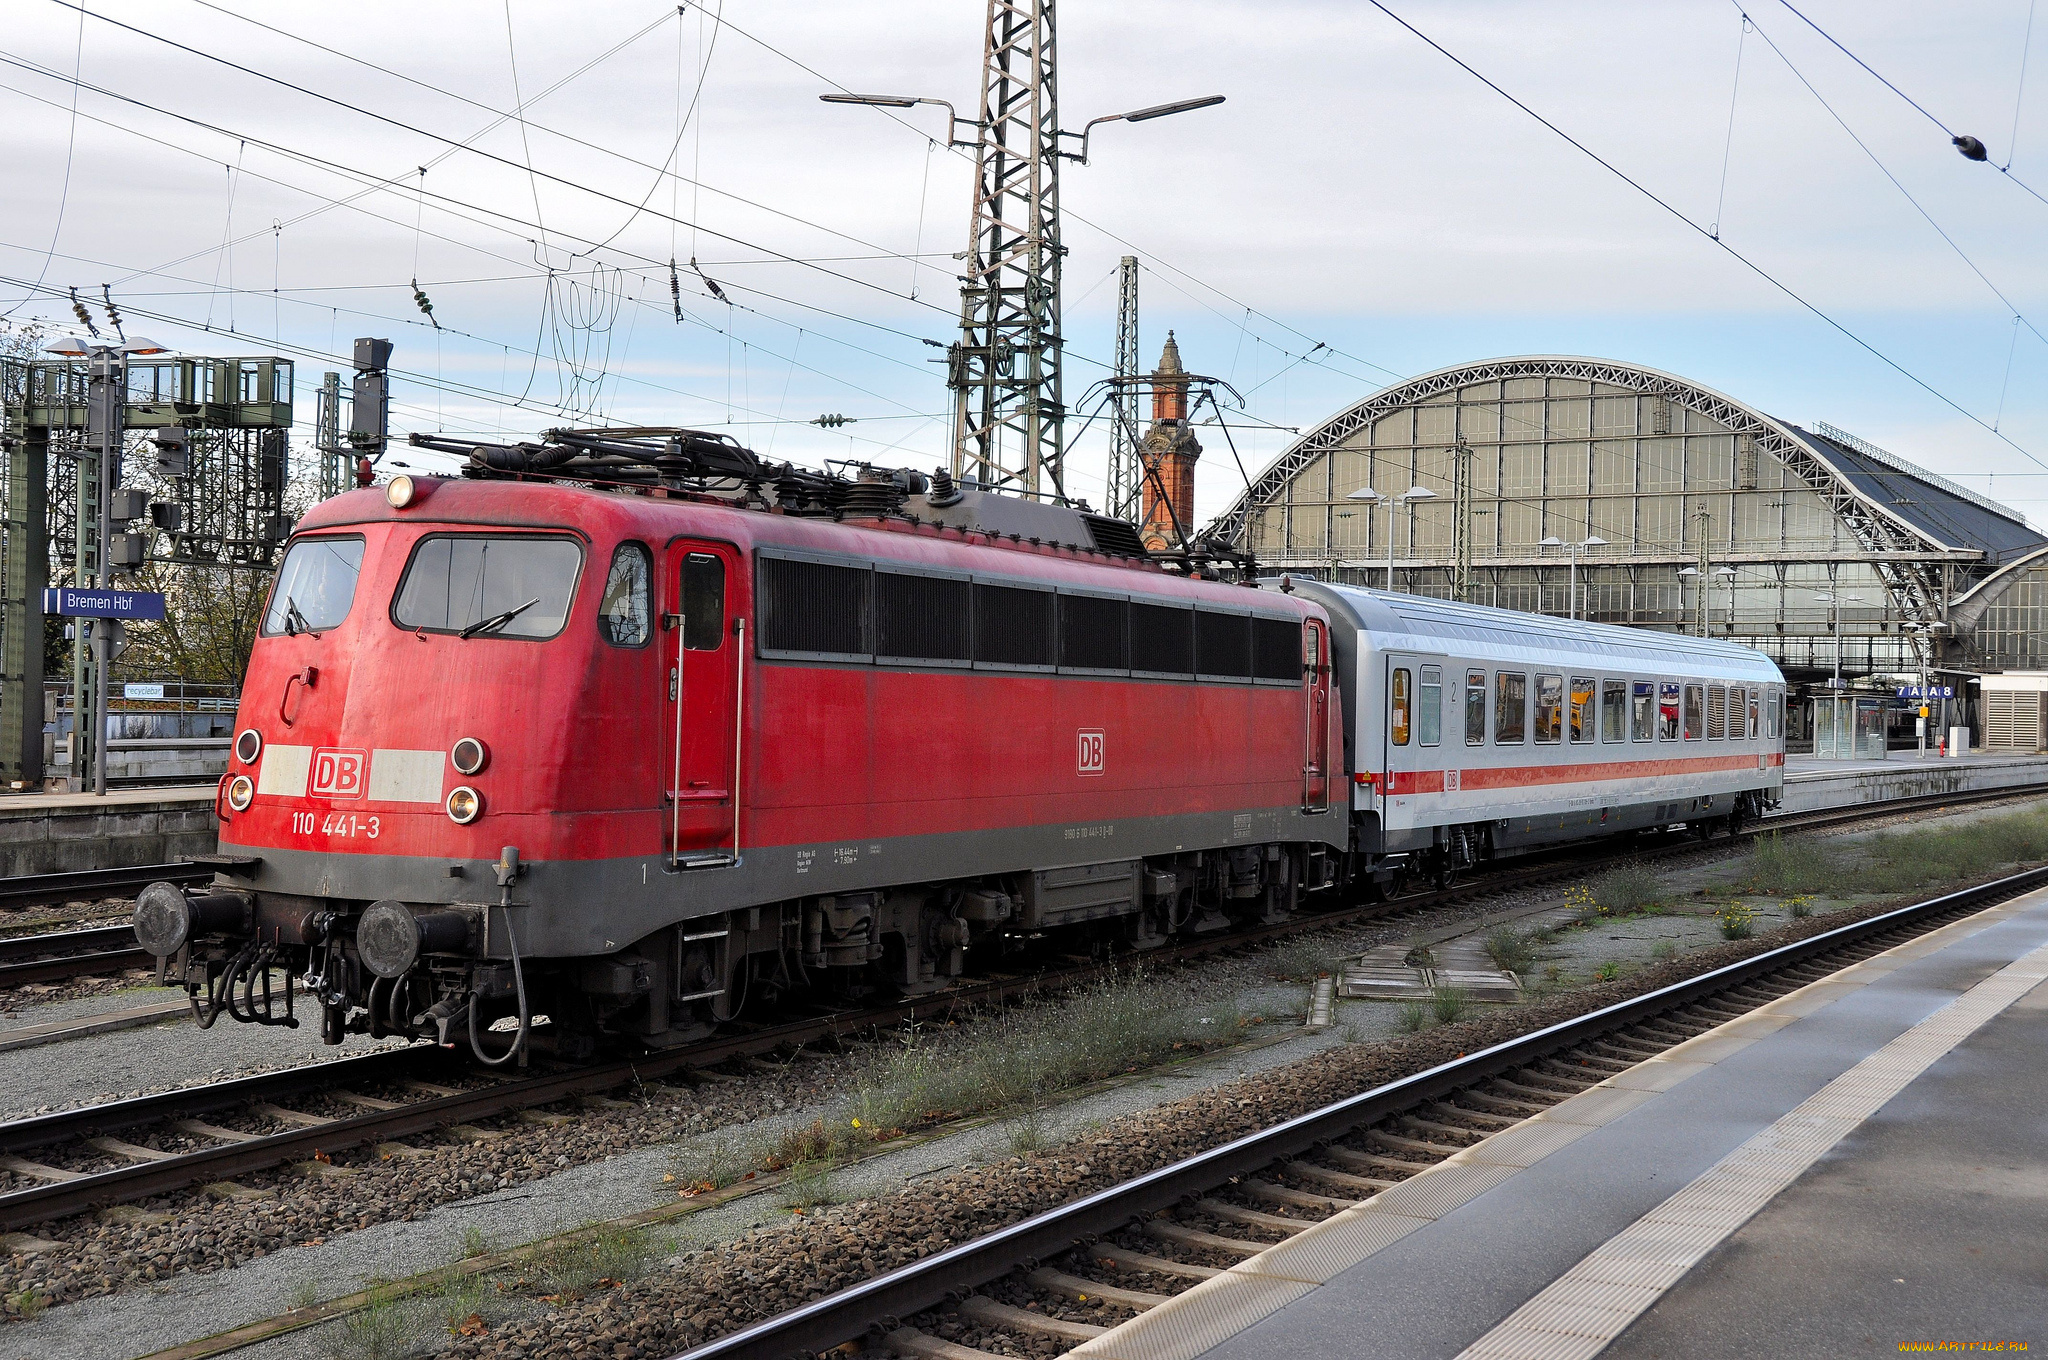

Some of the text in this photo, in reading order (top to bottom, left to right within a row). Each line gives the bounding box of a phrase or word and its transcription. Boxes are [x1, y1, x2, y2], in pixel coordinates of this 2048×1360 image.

[67, 593, 133, 610] Bremen Hbf
[1451, 681, 1456, 702] 2
[1897, 686, 1951, 696] 7 A A 8
[1080, 736, 1102, 767] DB
[316, 755, 358, 791] DB
[1448, 772, 1456, 787] DB
[292, 812, 380, 839] 110 441-3
[641, 863, 647, 885] 1
